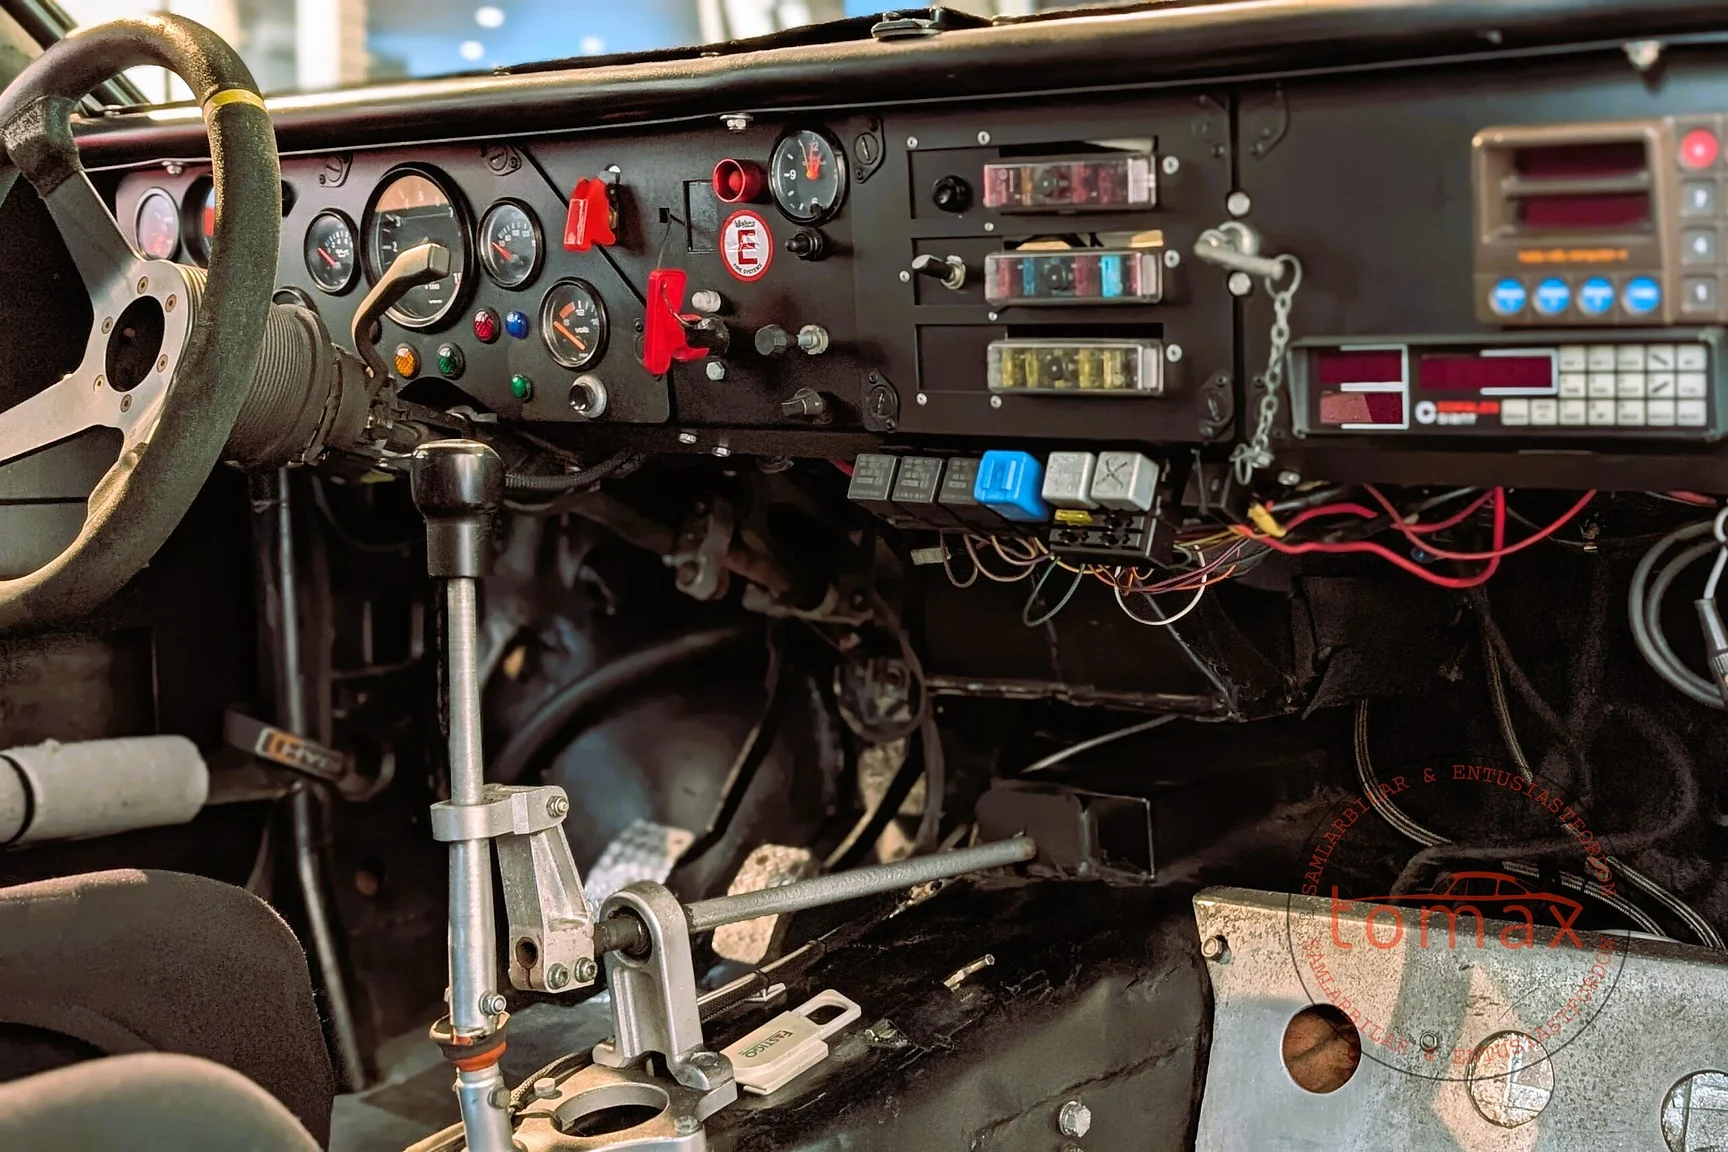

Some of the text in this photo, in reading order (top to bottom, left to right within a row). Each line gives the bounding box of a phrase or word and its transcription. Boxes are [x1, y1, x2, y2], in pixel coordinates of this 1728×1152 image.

[789, 169, 797, 180] 9
[395, 216, 402, 227] 3
[392, 241, 398, 252] 2
[737, 229, 758, 264] E
[575, 308, 585, 317] 12
[744, 1030, 793, 1058] FASTIGO
